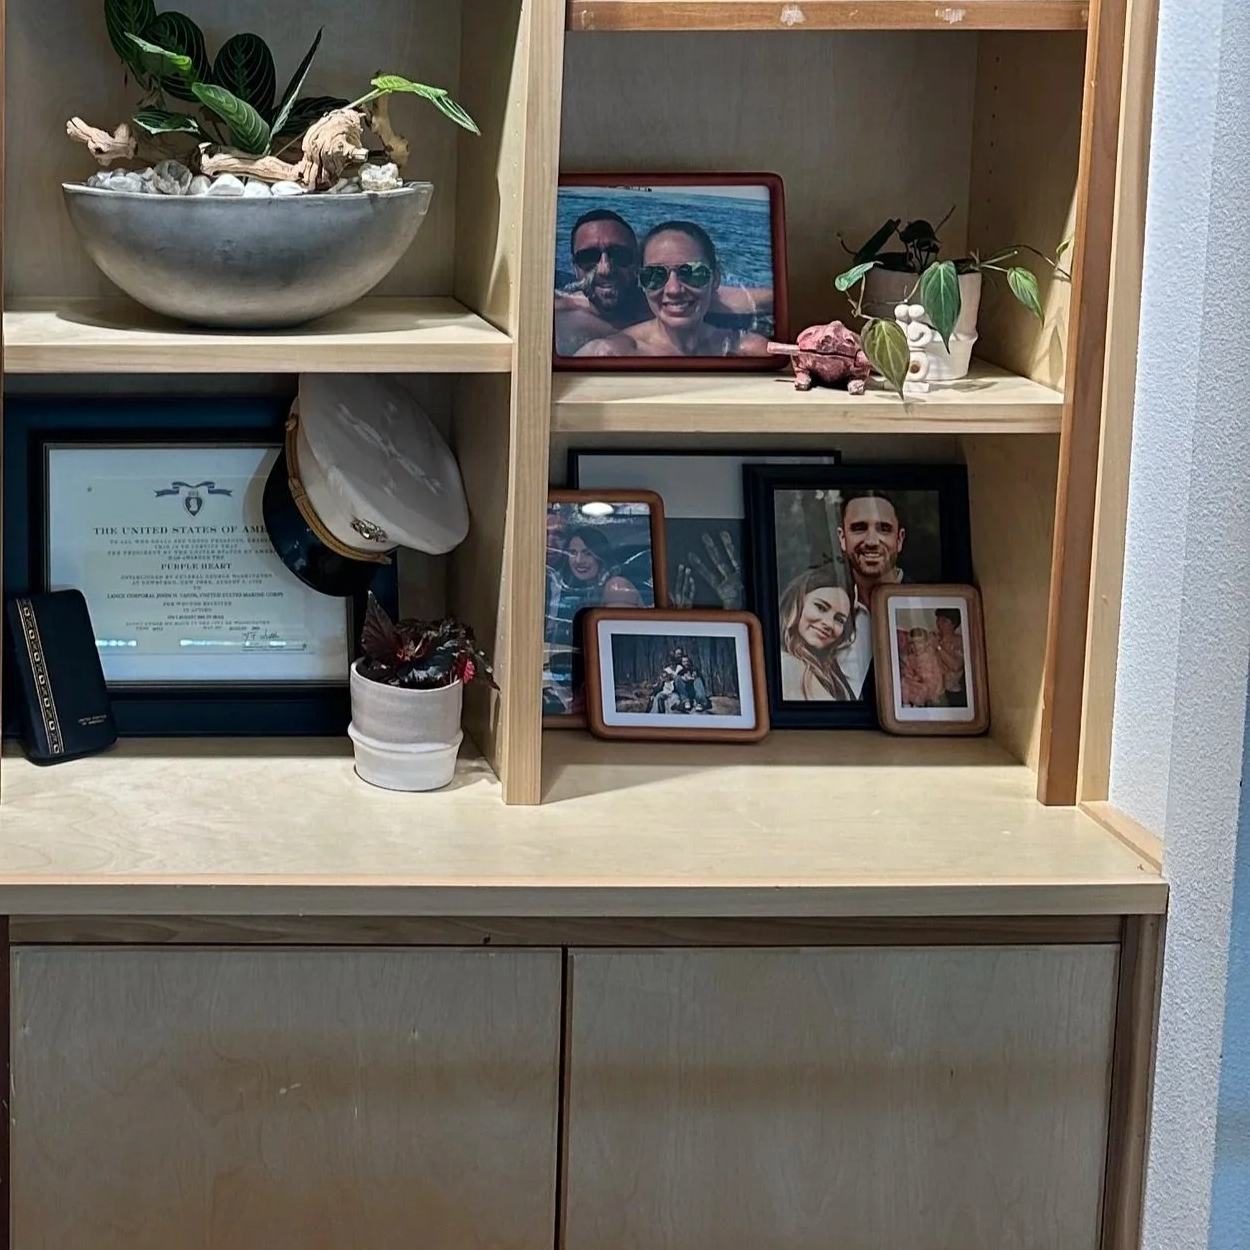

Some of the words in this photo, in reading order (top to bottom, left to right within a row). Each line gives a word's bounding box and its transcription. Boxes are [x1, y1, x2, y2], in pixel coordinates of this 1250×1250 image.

[94, 526, 118, 535] THE
[122, 526, 168, 535] UNITED
[172, 526, 217, 534] STATES
[221, 525, 238, 534] OF
